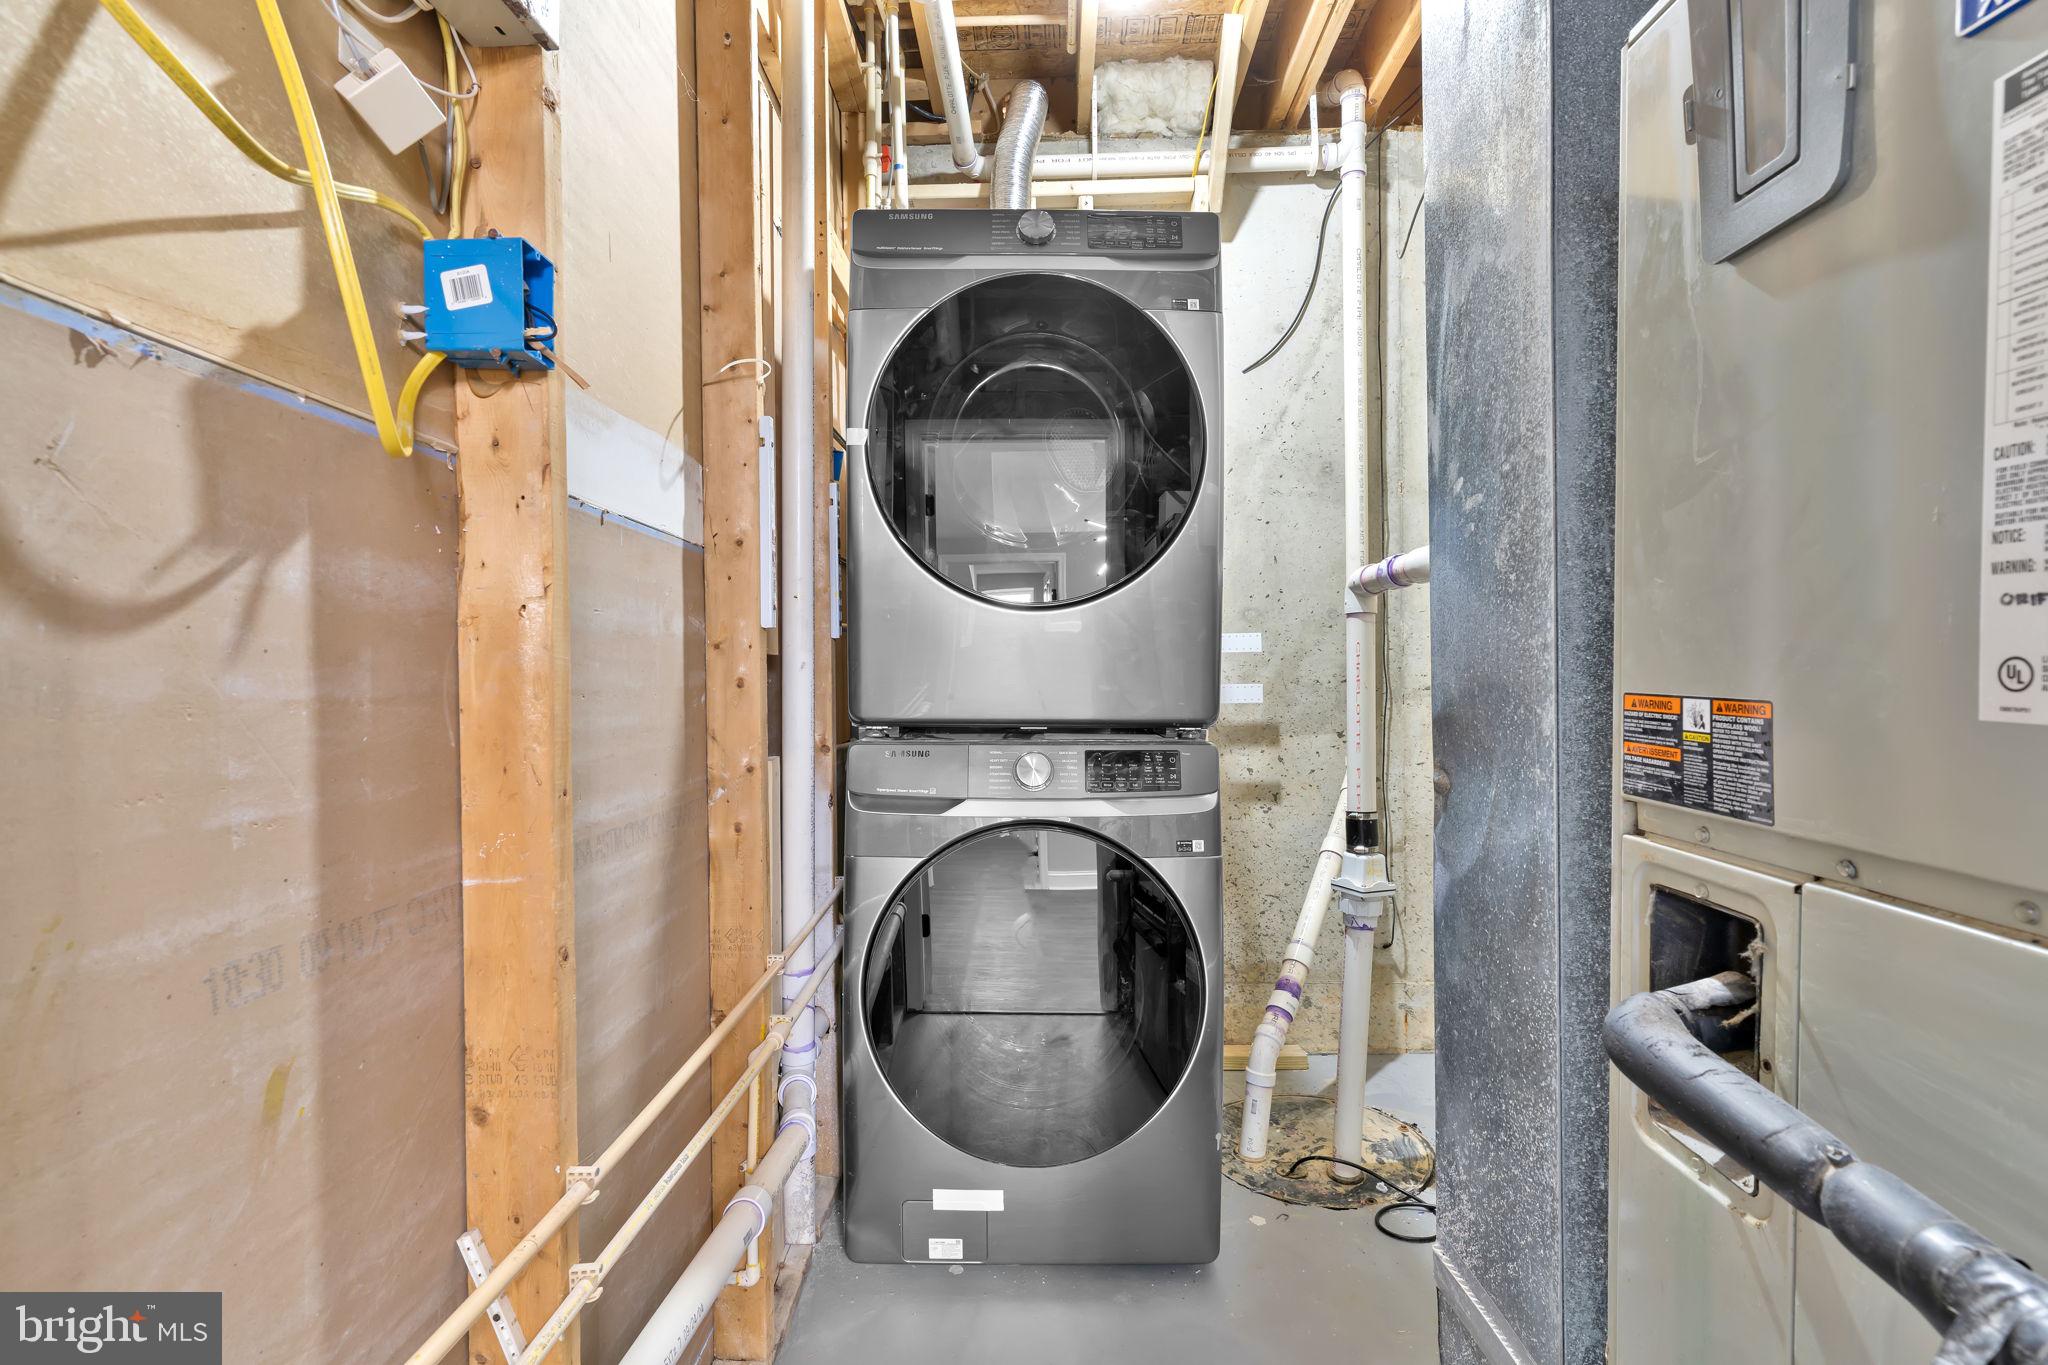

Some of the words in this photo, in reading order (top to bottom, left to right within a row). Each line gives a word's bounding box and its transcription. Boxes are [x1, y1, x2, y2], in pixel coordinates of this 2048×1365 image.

[1638, 698, 1673, 711] WARNING
[1724, 703, 1767, 716] WARNING
[1688, 733, 1710, 742] CAUTION
[1631, 746, 1678, 759] AVERTISSEMENT
